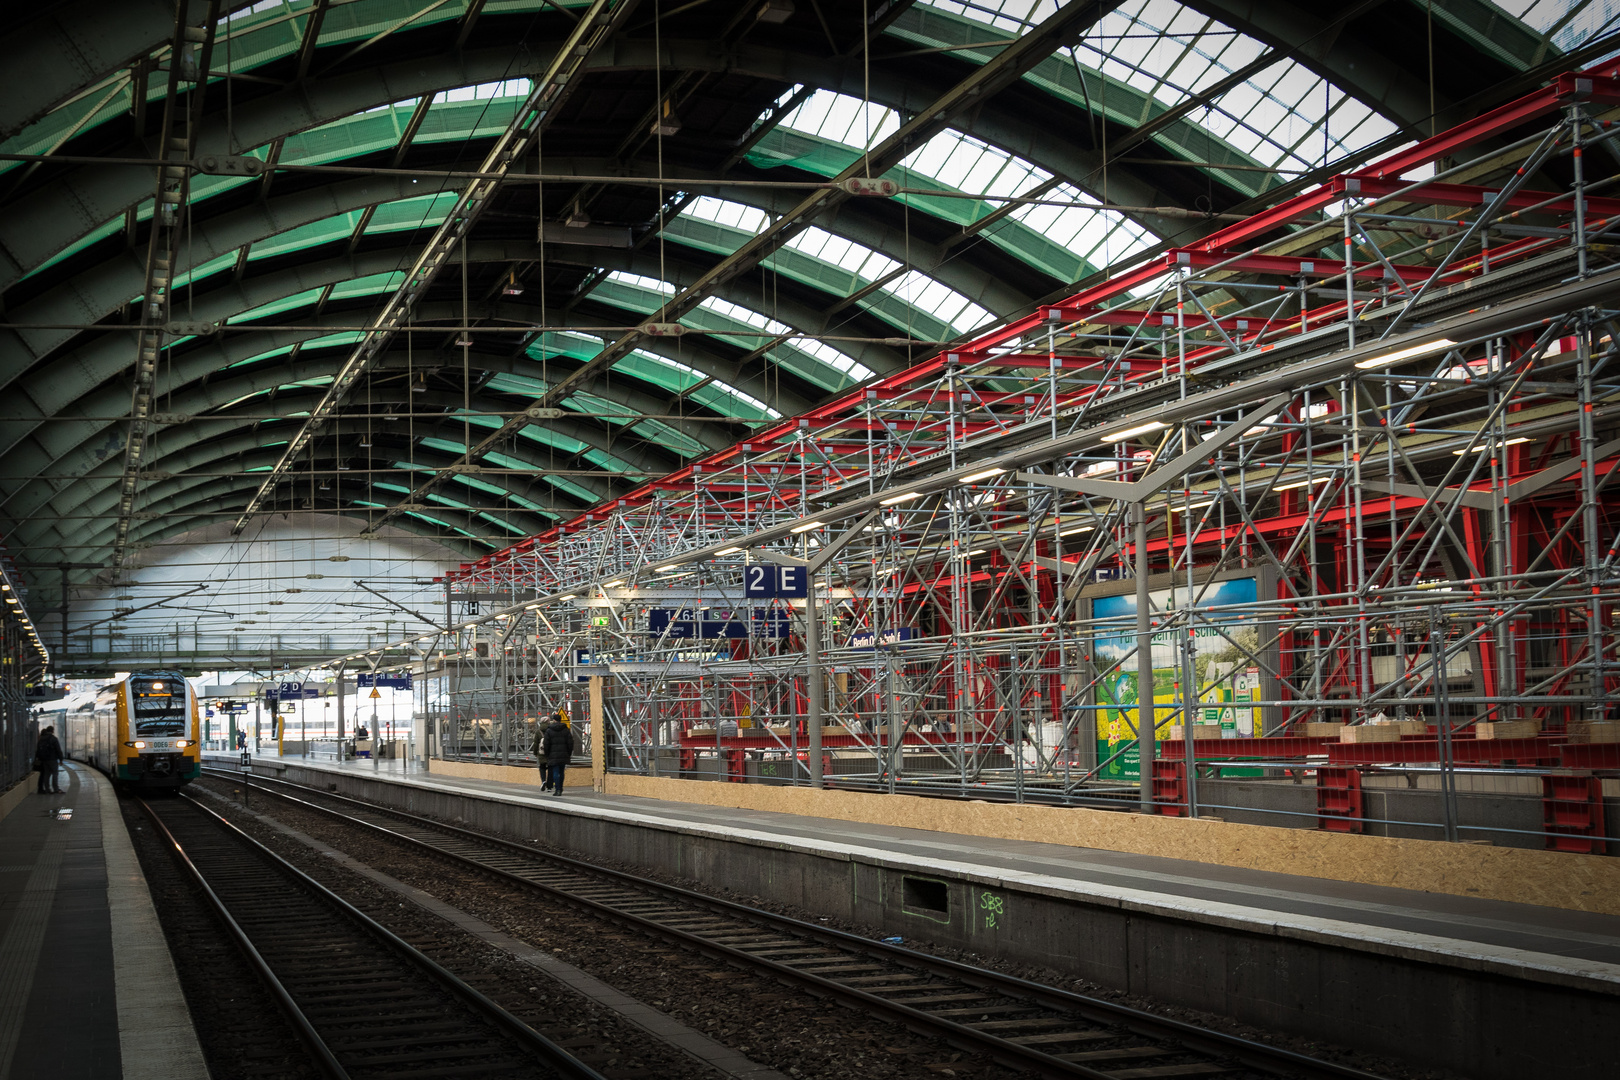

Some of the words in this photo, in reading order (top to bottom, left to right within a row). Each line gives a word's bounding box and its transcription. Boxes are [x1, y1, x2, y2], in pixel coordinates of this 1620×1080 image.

[749, 566, 764, 590] 2
[781, 567, 796, 590] E
[470, 603, 478, 614] H
[853, 636, 868, 647] Berlin
[282, 683, 288, 691] 2
[292, 683, 299, 691] D
[242, 755, 250, 765] H
